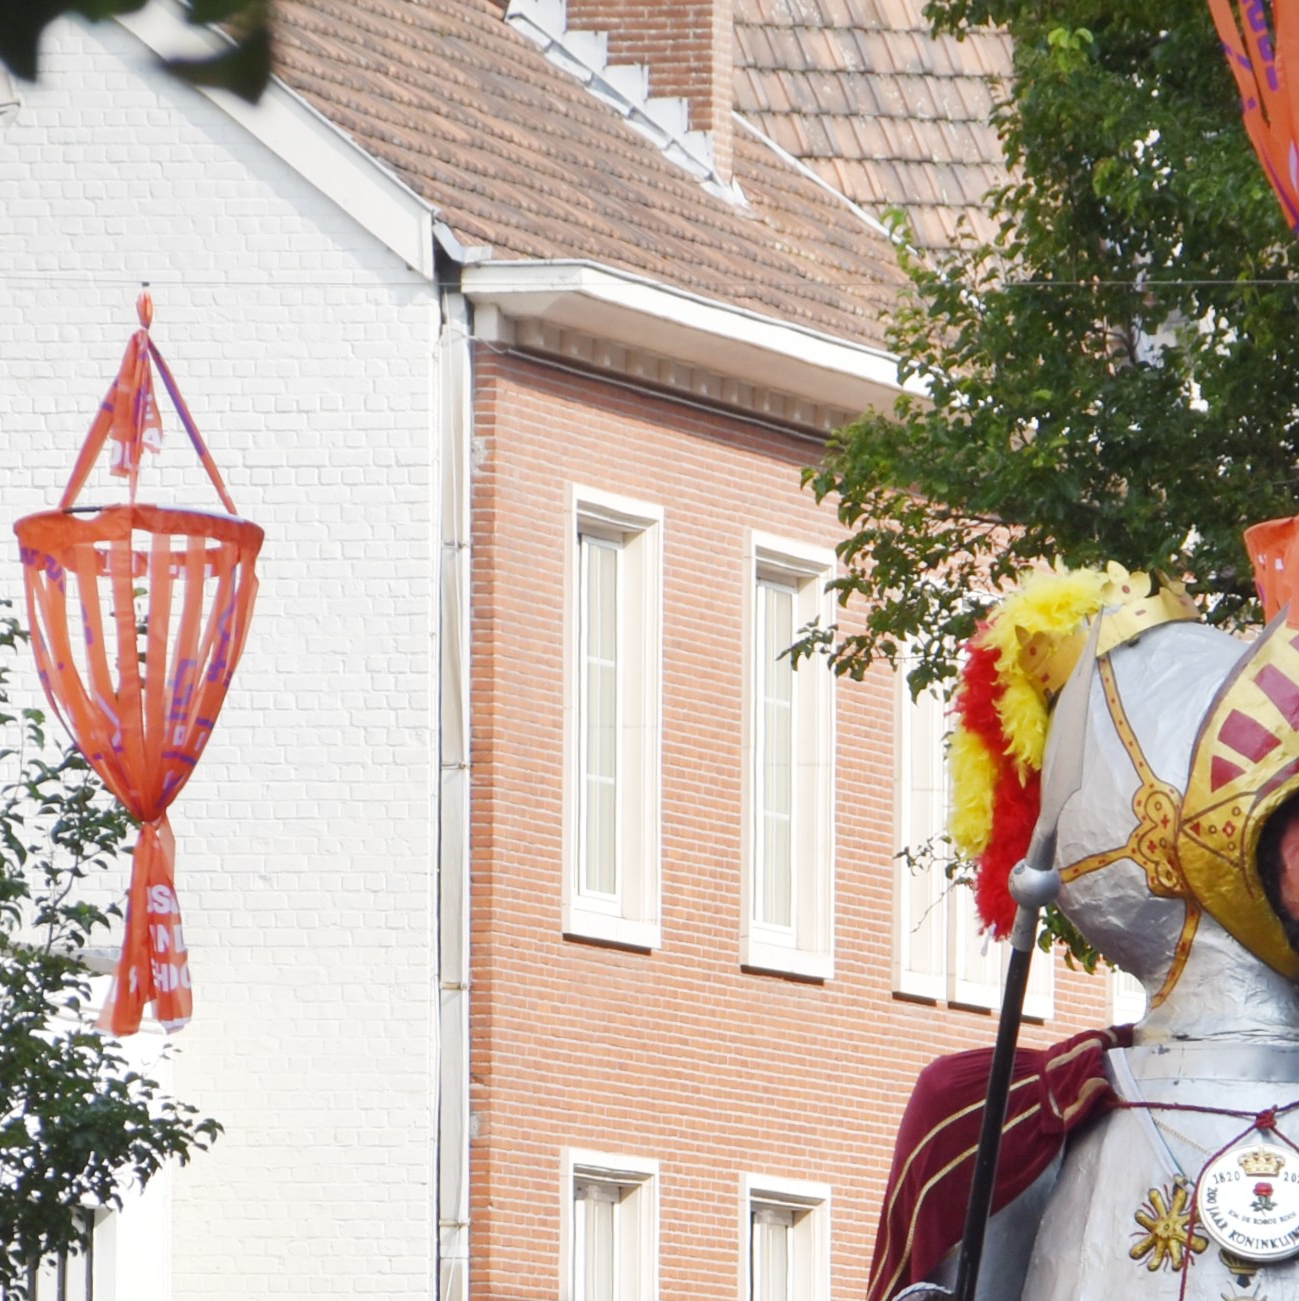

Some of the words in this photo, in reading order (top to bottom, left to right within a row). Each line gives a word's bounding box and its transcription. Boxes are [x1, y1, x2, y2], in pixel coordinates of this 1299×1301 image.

[1213, 1171, 1240, 1185] 1820
[1206, 1187, 1218, 1203] 200
[1205, 1206, 1228, 1231] JAAR
